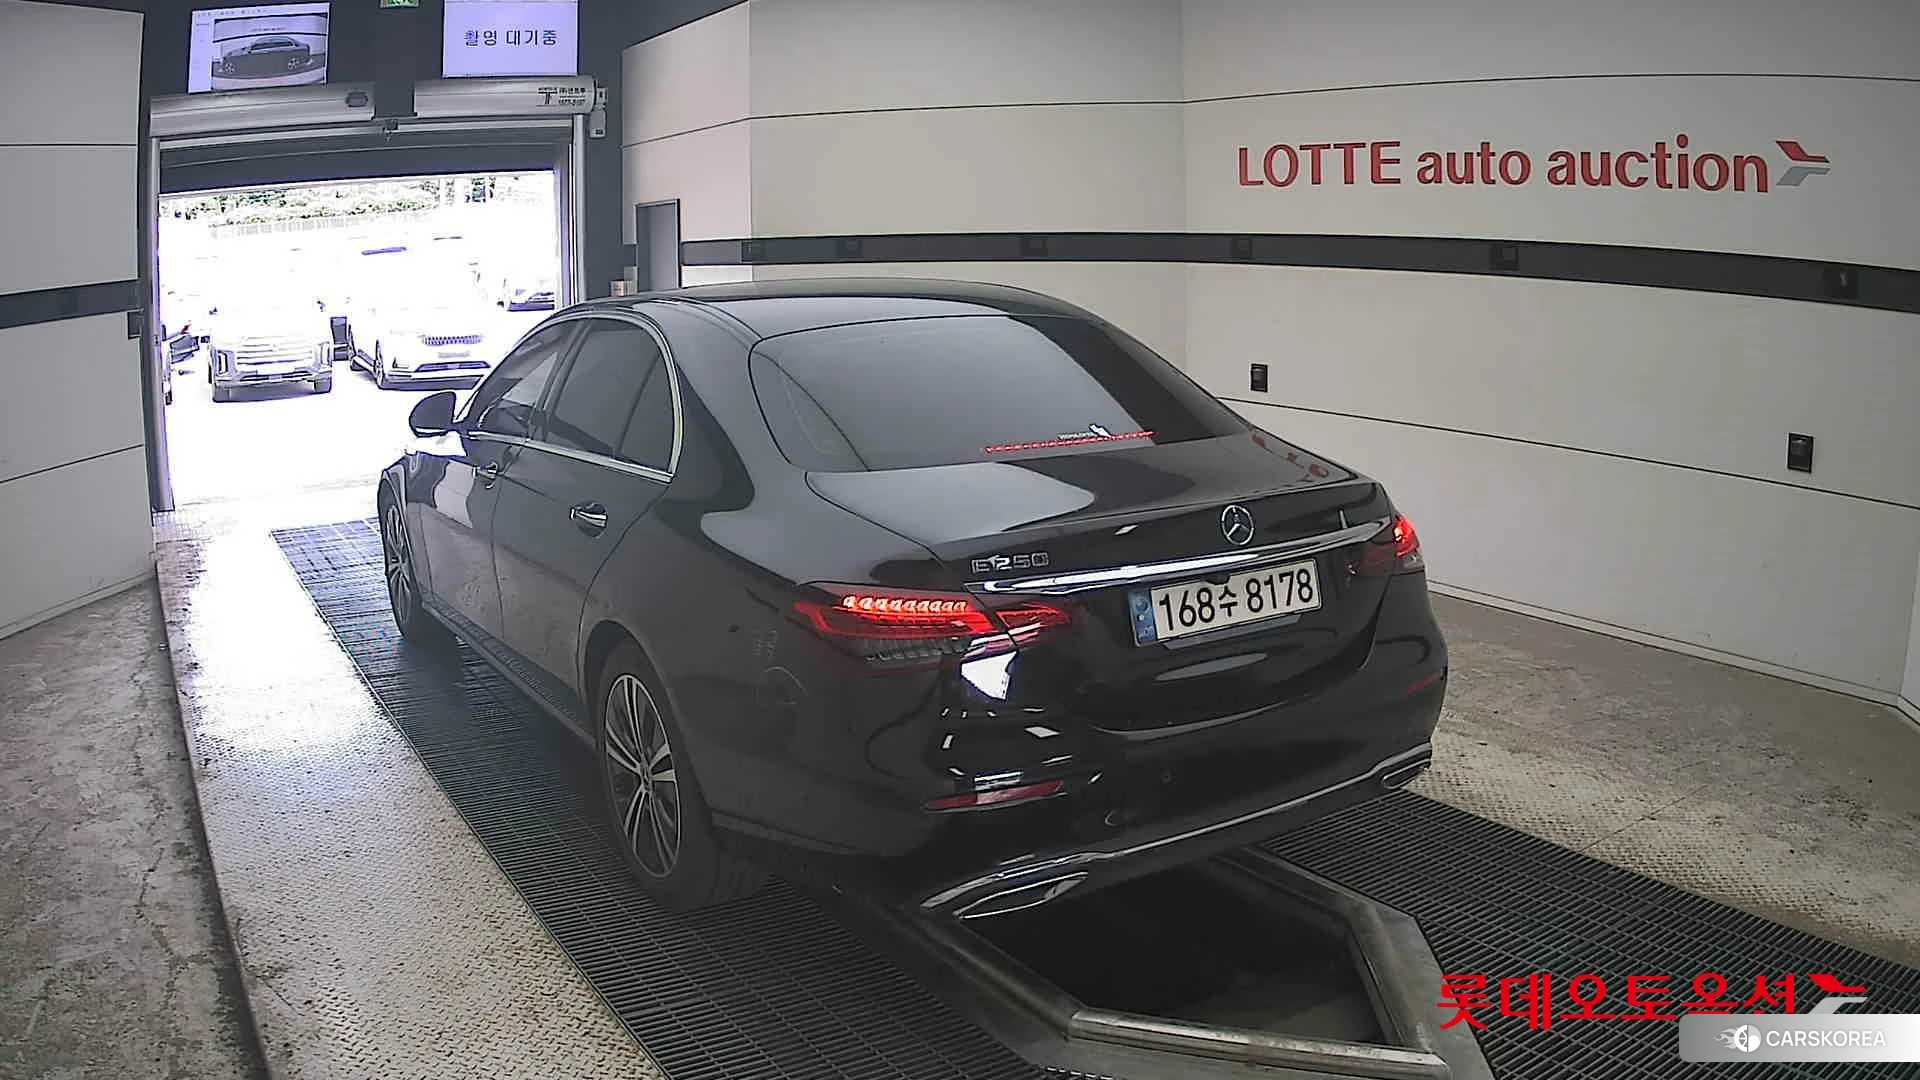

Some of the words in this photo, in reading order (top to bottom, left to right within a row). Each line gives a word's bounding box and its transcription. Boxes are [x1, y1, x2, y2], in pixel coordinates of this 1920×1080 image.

[463, 29, 497, 46] 촬영
[506, 29, 557, 46] 대기중
[1239, 141, 1401, 187] LOTTE
[1416, 142, 1531, 185] auto
[1547, 134, 1768, 193] auction
